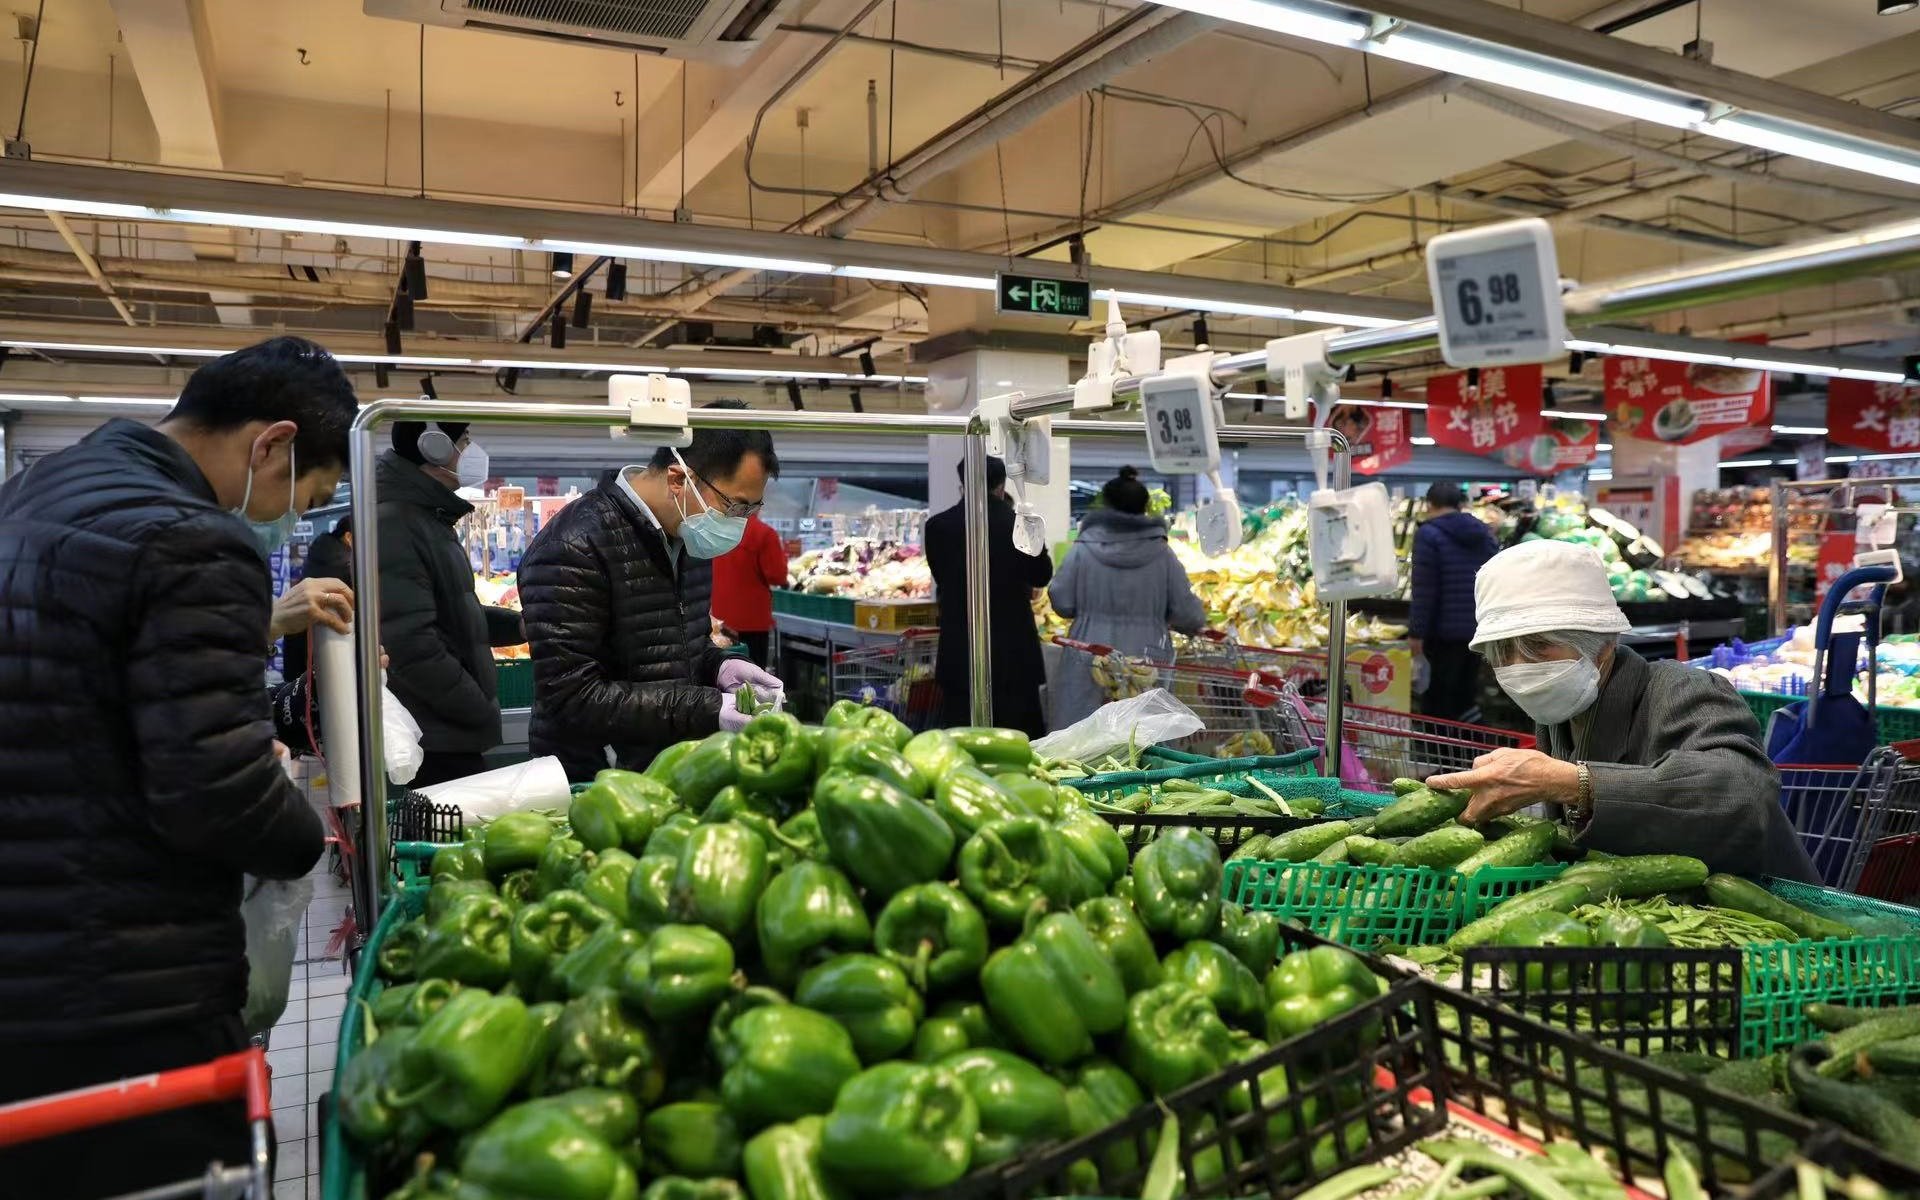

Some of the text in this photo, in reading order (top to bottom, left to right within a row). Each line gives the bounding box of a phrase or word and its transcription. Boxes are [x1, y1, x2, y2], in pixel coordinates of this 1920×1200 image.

[1458, 272, 1520, 326] 6.98
[1157, 408, 1192, 444] 3.98
[1446, 402, 1519, 448] 火锅节
